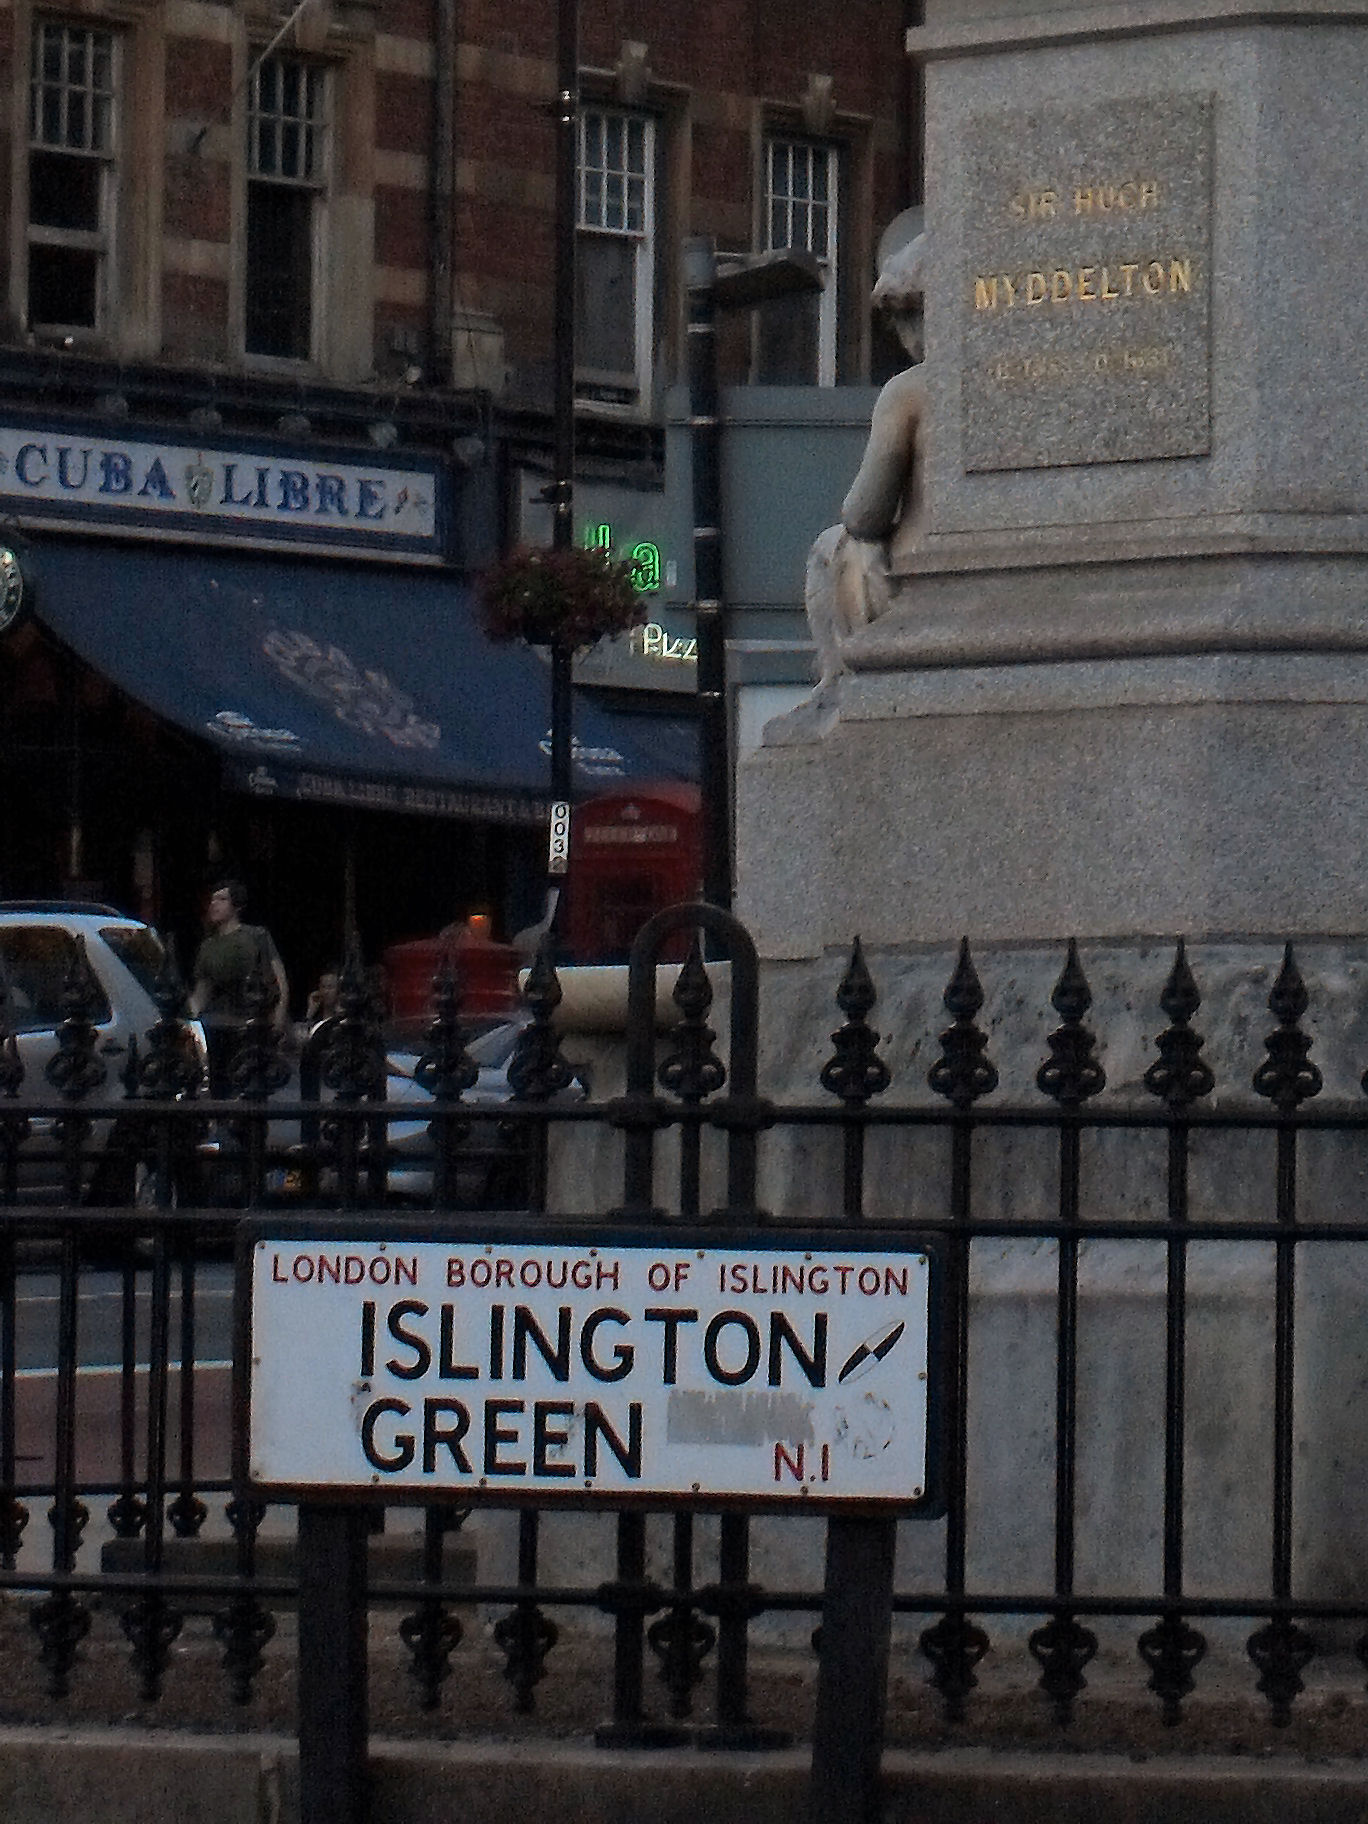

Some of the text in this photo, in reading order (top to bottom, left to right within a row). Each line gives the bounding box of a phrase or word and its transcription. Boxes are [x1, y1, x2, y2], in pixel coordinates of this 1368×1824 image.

[1009, 180, 1160, 221] SIR HUGH
[974, 257, 1192, 311] MYDDELTON
[14, 443, 388, 521] CUBA LIBRE
[553, 804, 568, 854] 003
[271, 1253, 910, 1297] LONDON BOROUGH OF ISLINGTON
[360, 1299, 828, 1389] ISLINGTON
[360, 1397, 643, 1480] GREEN
